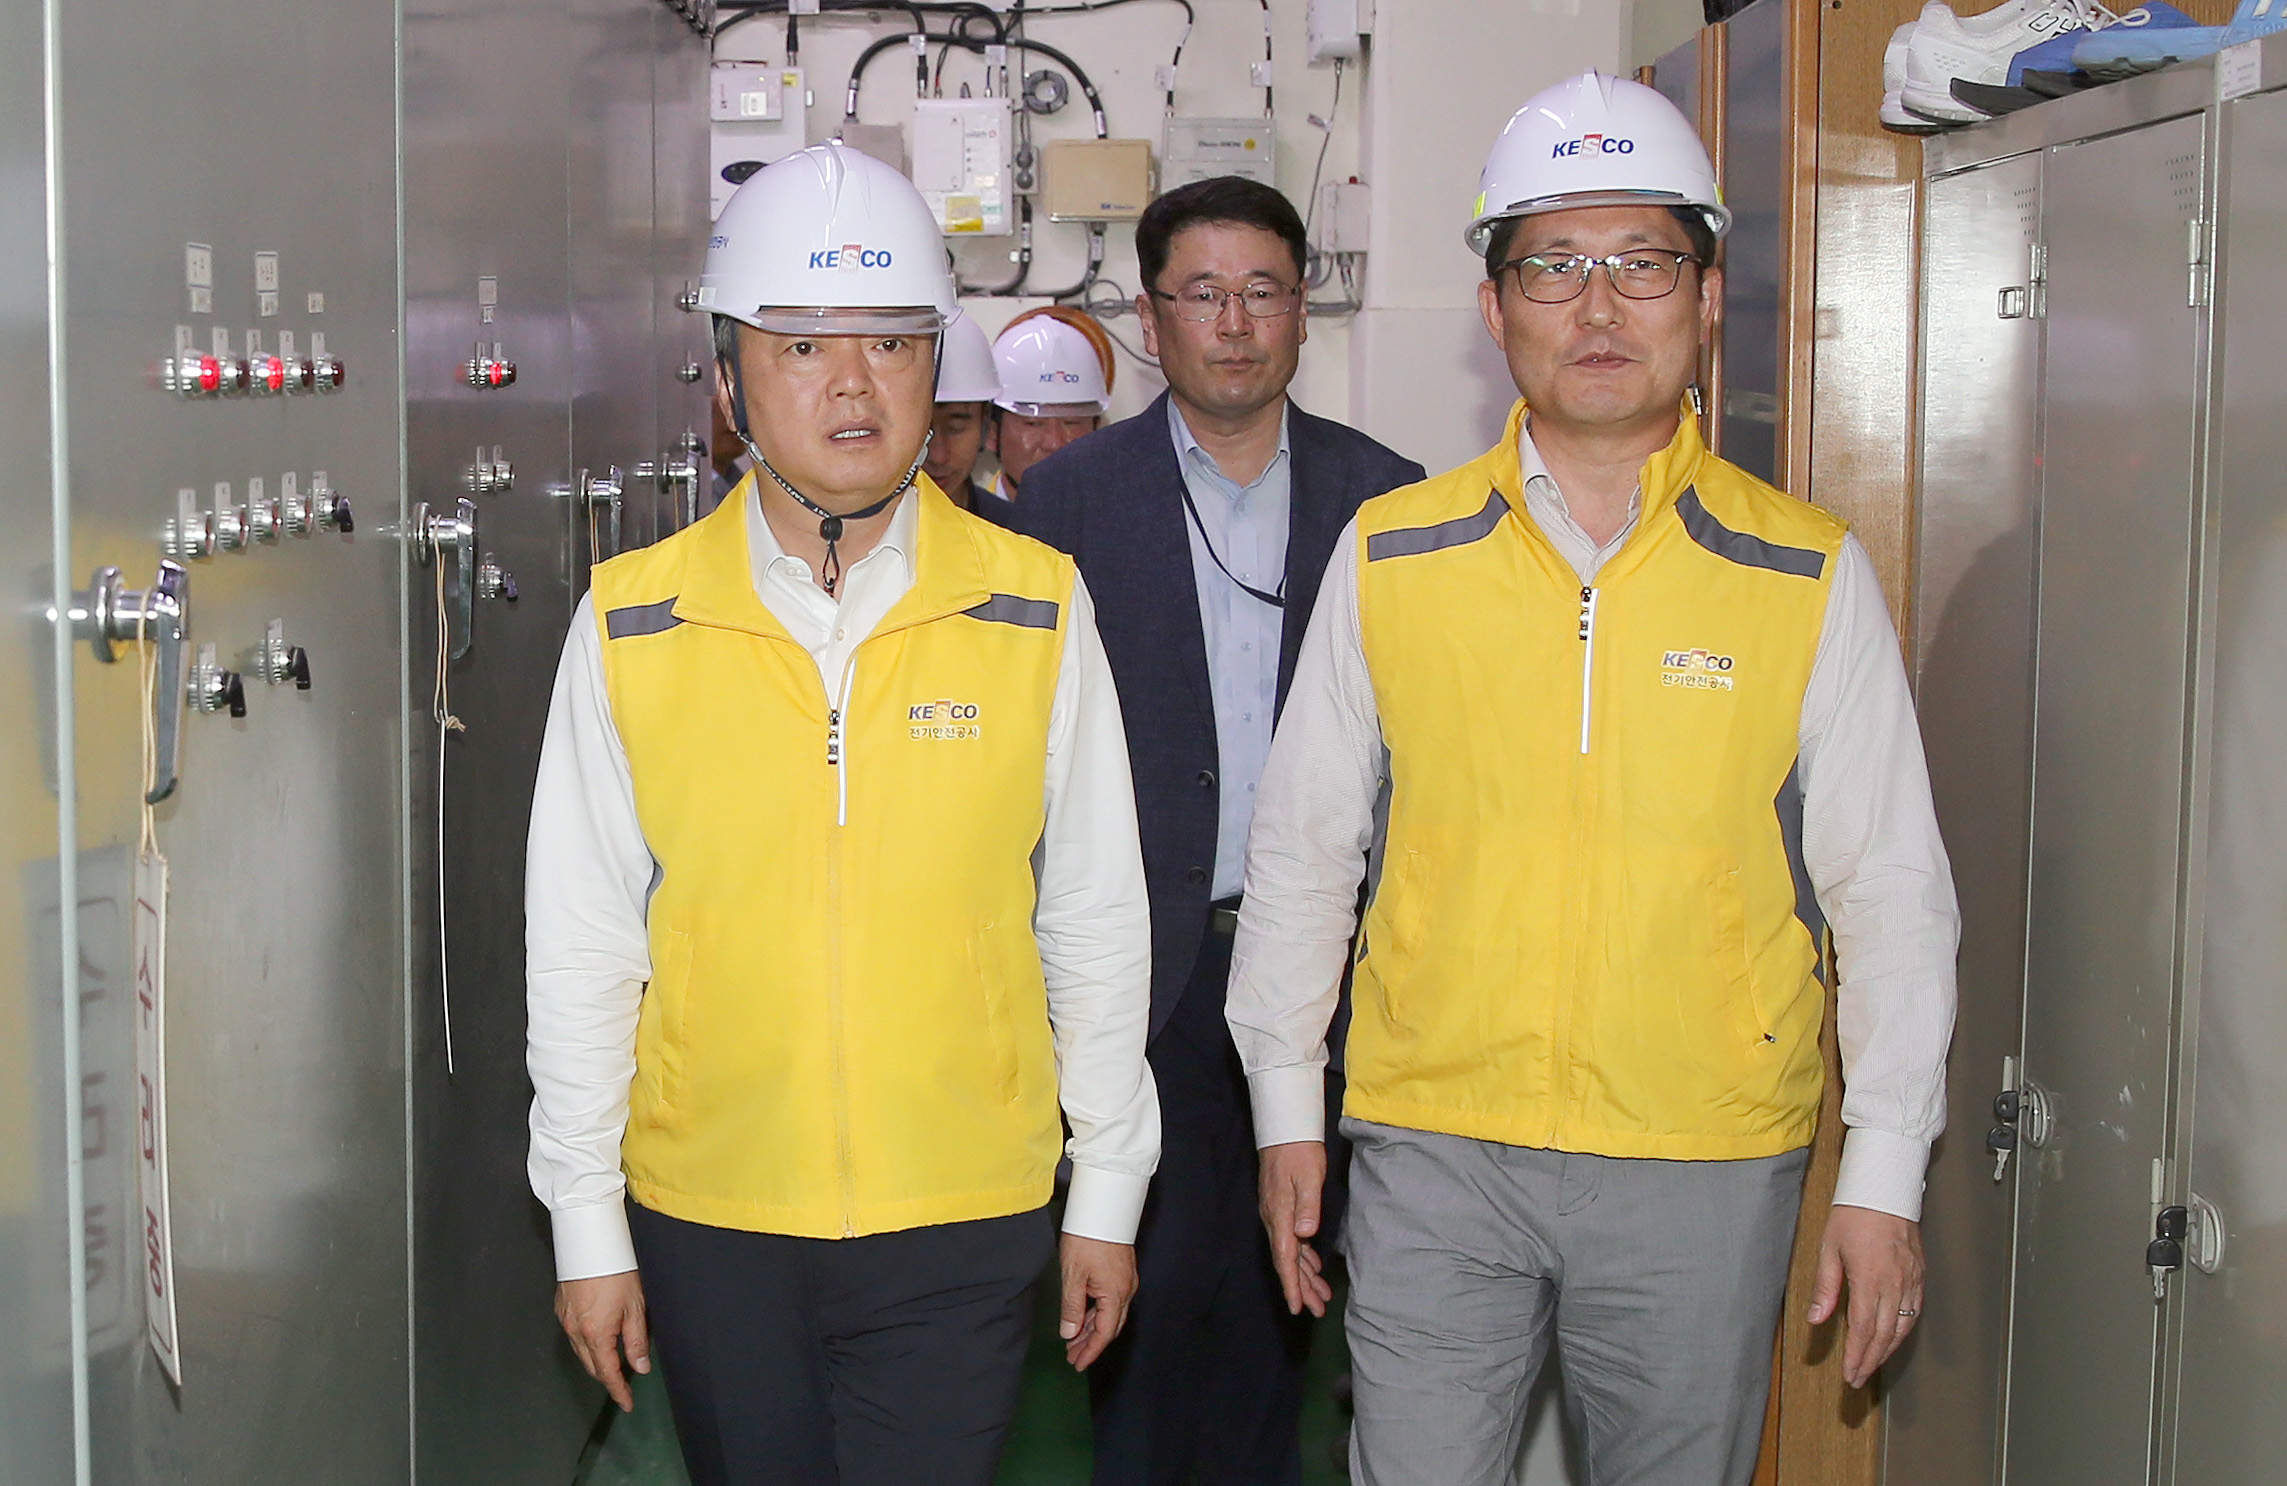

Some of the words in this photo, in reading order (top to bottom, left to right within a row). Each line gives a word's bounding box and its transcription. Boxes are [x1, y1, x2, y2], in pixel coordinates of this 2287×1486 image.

[1552, 133, 1634, 159] KESCO
[809, 244, 892, 272] KESCO
[1039, 371, 1080, 385] KECO
[1662, 649, 1733, 673] KESCO
[1662, 674, 1733, 690] 전기안전공사
[908, 700, 978, 723] KESCO
[909, 727, 978, 740] 전기안전공사
